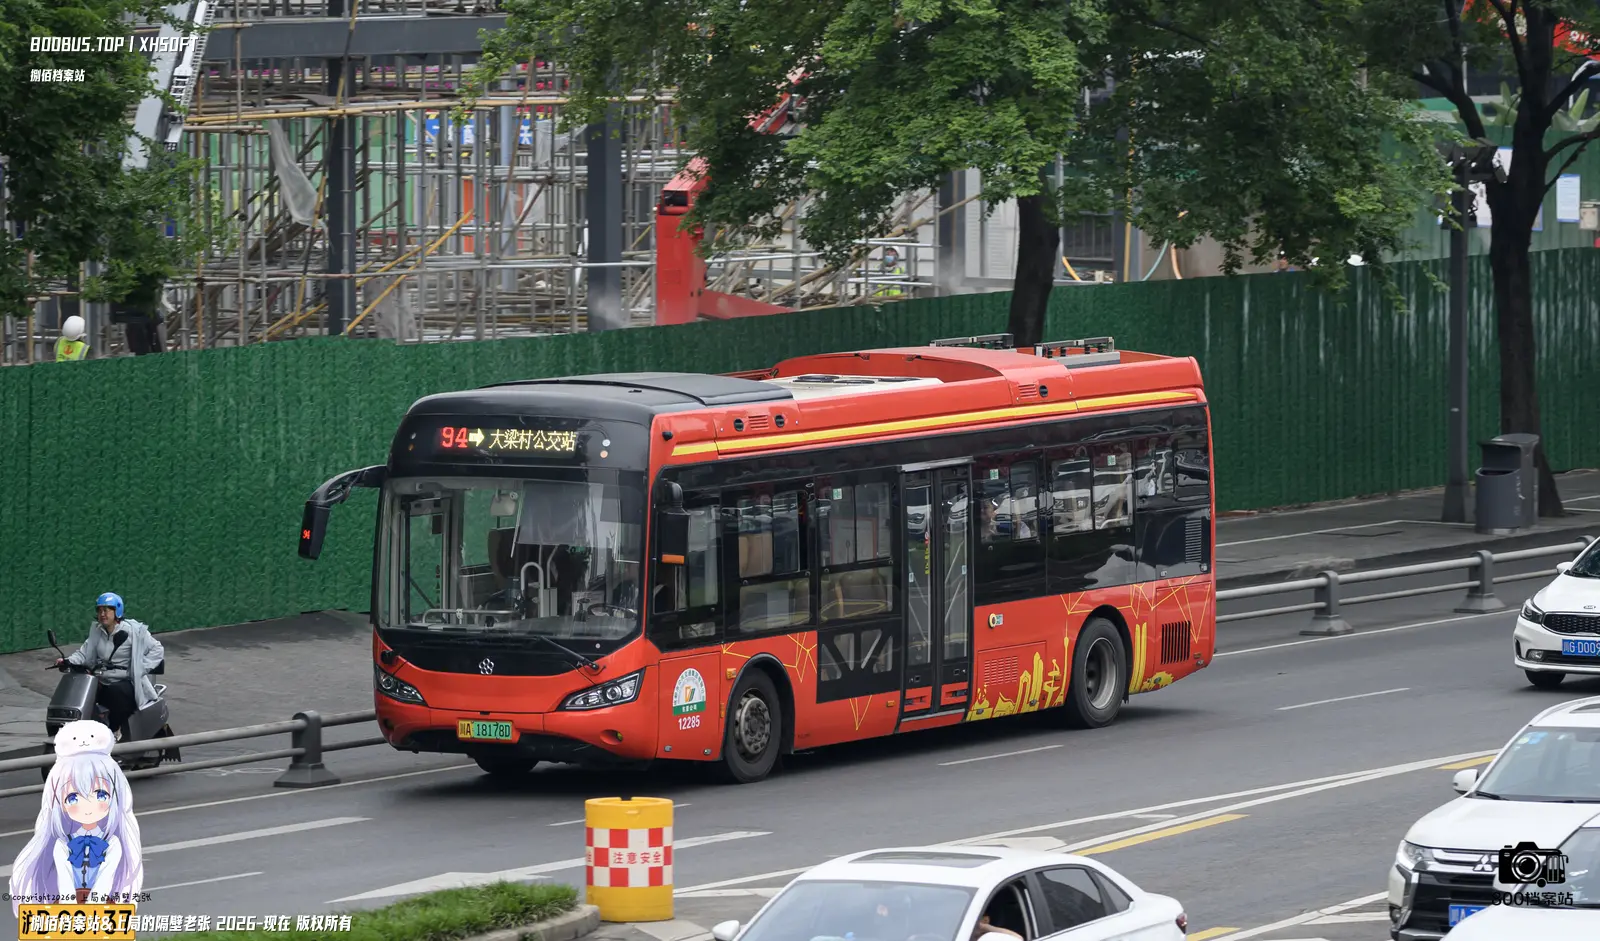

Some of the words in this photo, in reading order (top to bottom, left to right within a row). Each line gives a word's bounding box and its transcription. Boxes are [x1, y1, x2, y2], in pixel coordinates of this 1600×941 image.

[442, 426, 468, 448] 94
[488, 428, 577, 452] 大梁村公交站
[678, 715, 701, 731] 12285
[613, 851, 662, 865] 注意安全
